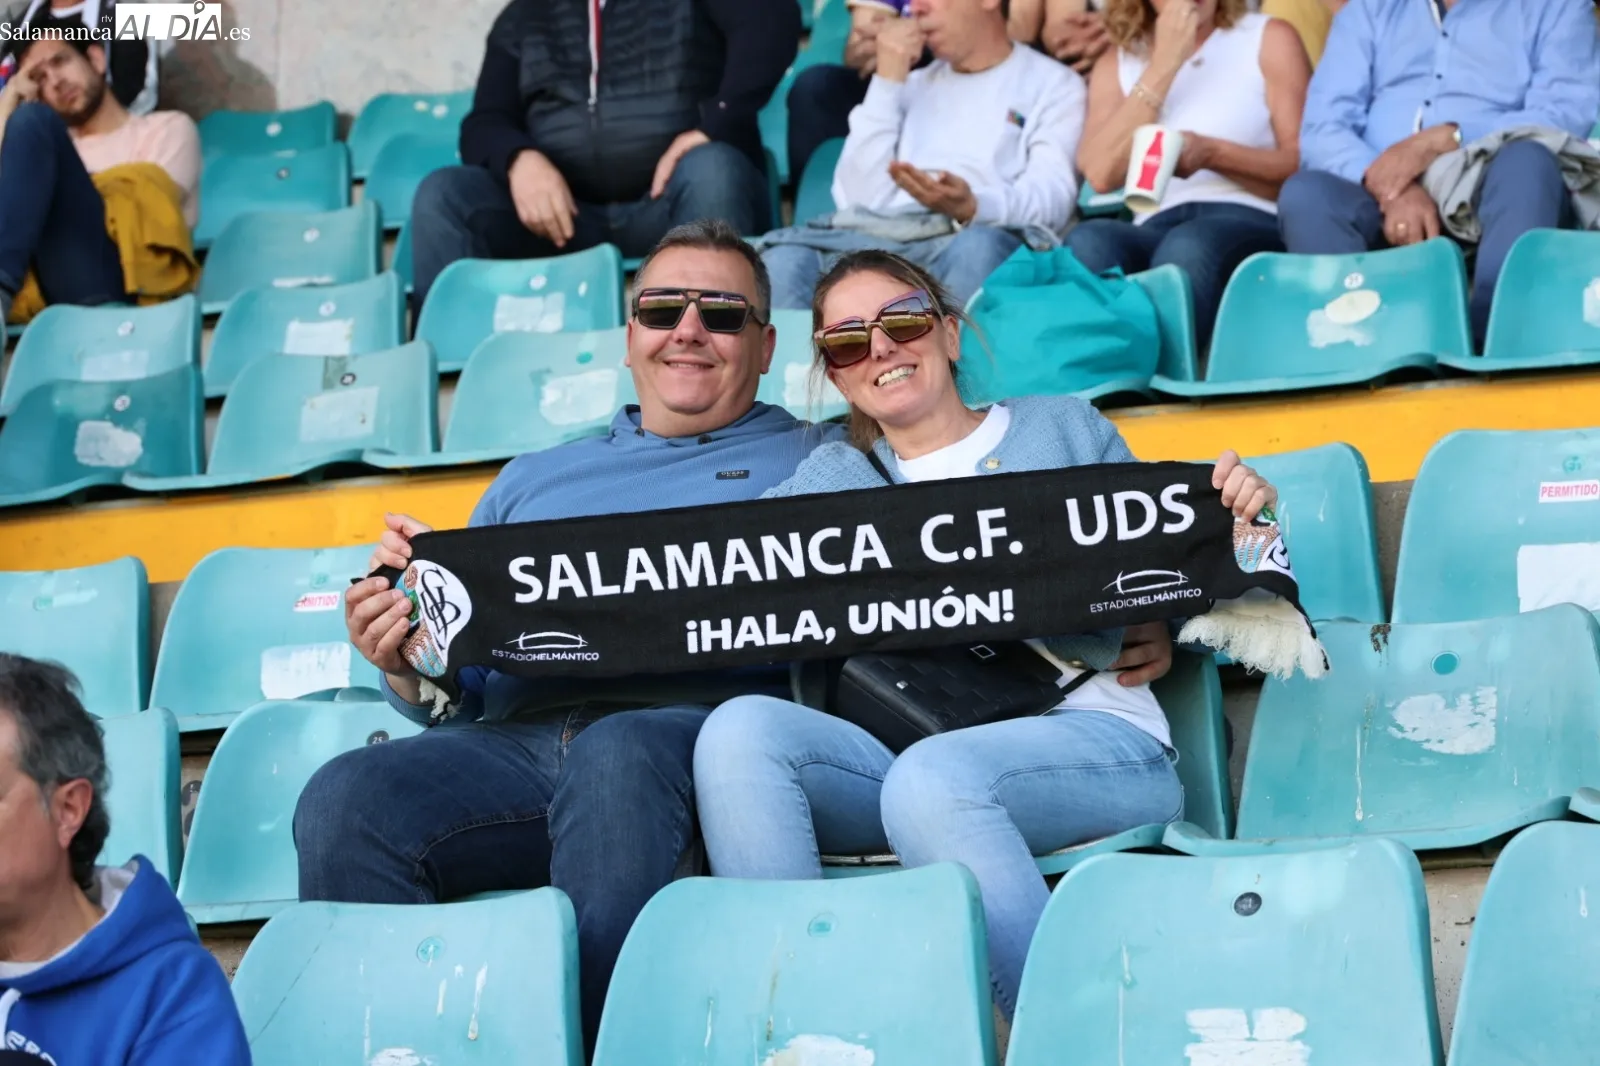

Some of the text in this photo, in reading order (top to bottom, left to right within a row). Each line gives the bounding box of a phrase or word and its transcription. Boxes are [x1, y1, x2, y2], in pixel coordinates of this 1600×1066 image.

[1541, 483, 1599, 499] PERMITIDO
[508, 483, 1196, 604] SALAMANCA C.F. UDS
[685, 585, 1015, 654] ¡HALA, UNIÓN!
[1089, 587, 1202, 614] ESTADIOHELMÁNTICO
